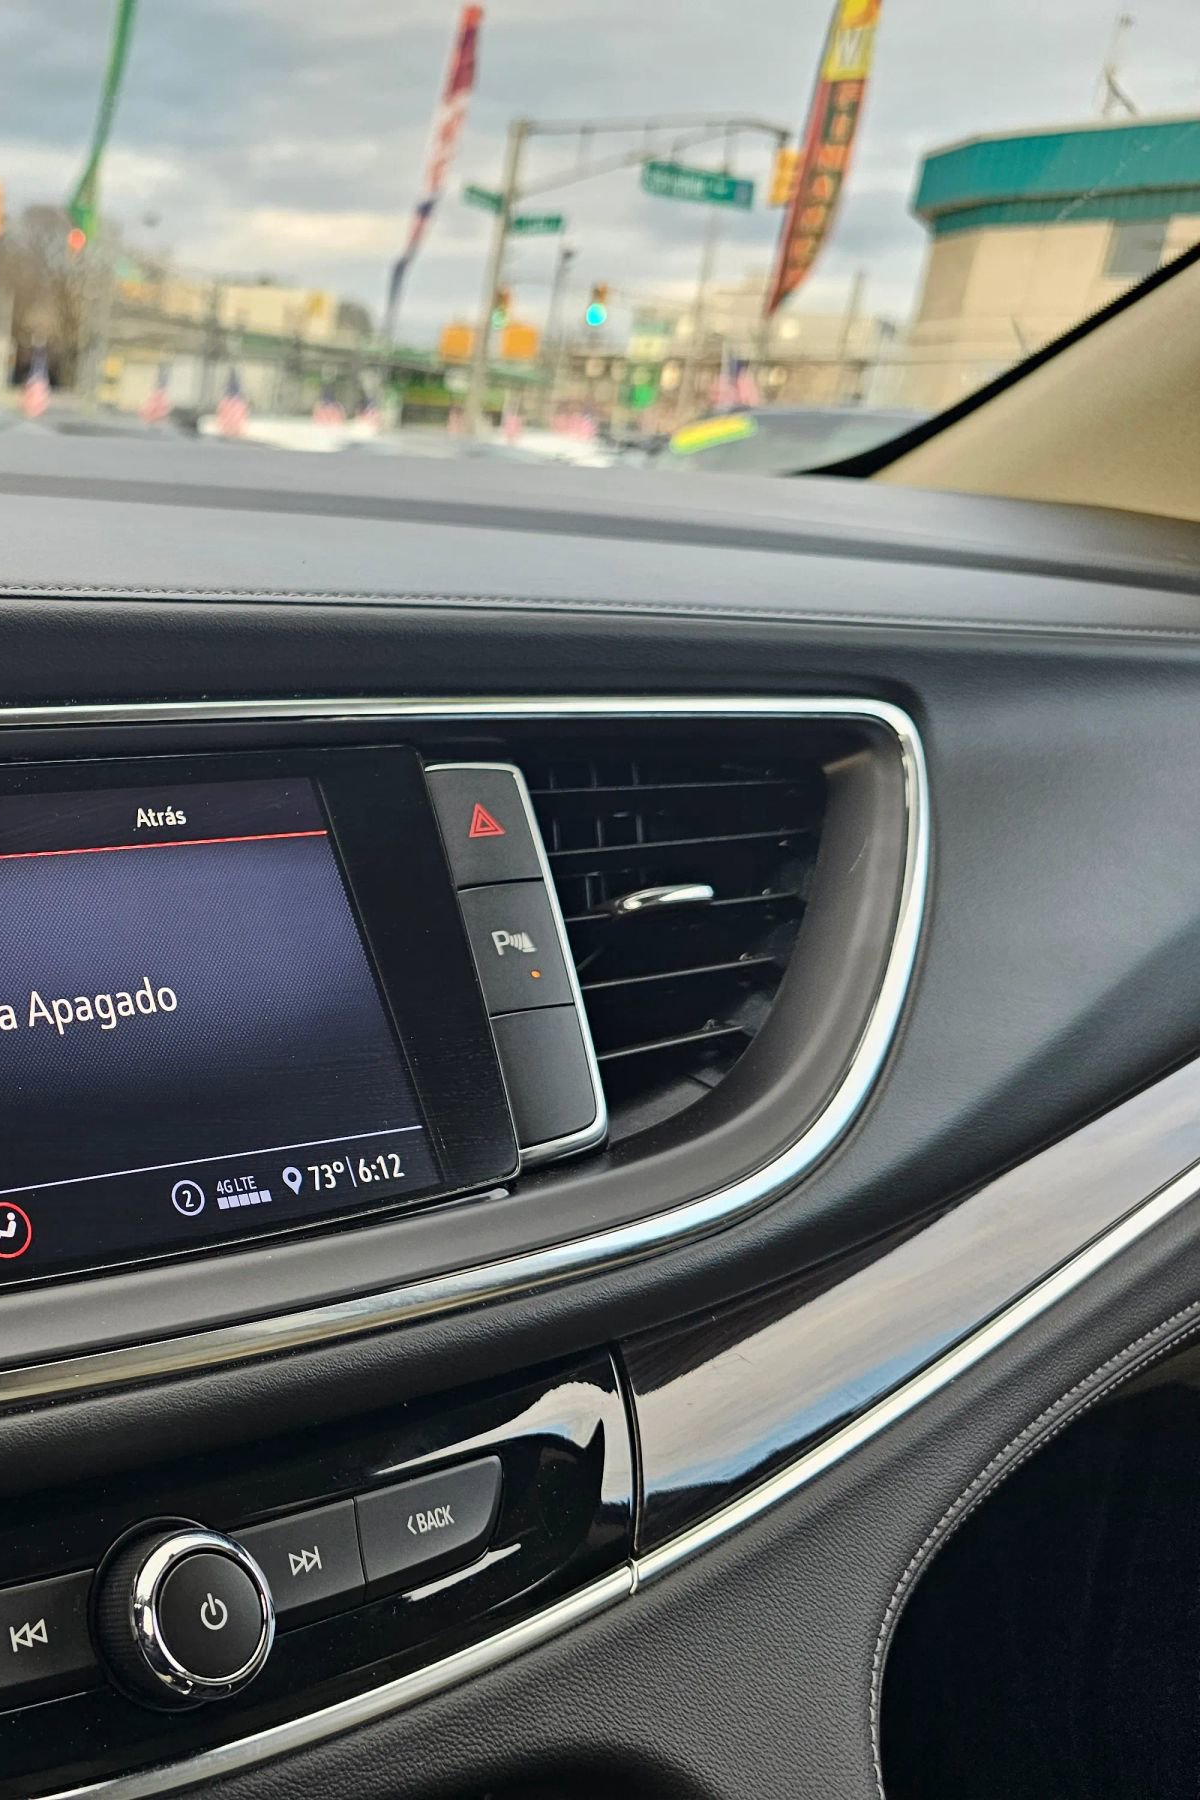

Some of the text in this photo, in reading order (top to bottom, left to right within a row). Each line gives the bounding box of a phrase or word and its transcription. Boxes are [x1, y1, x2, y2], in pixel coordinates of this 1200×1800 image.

[136, 805, 187, 828] Atrás
[28, 976, 178, 1036] Apagado
[357, 1153, 405, 1184] 6:12
[216, 1175, 258, 1195] 4G LTE
[181, 1189, 195, 1208] 2
